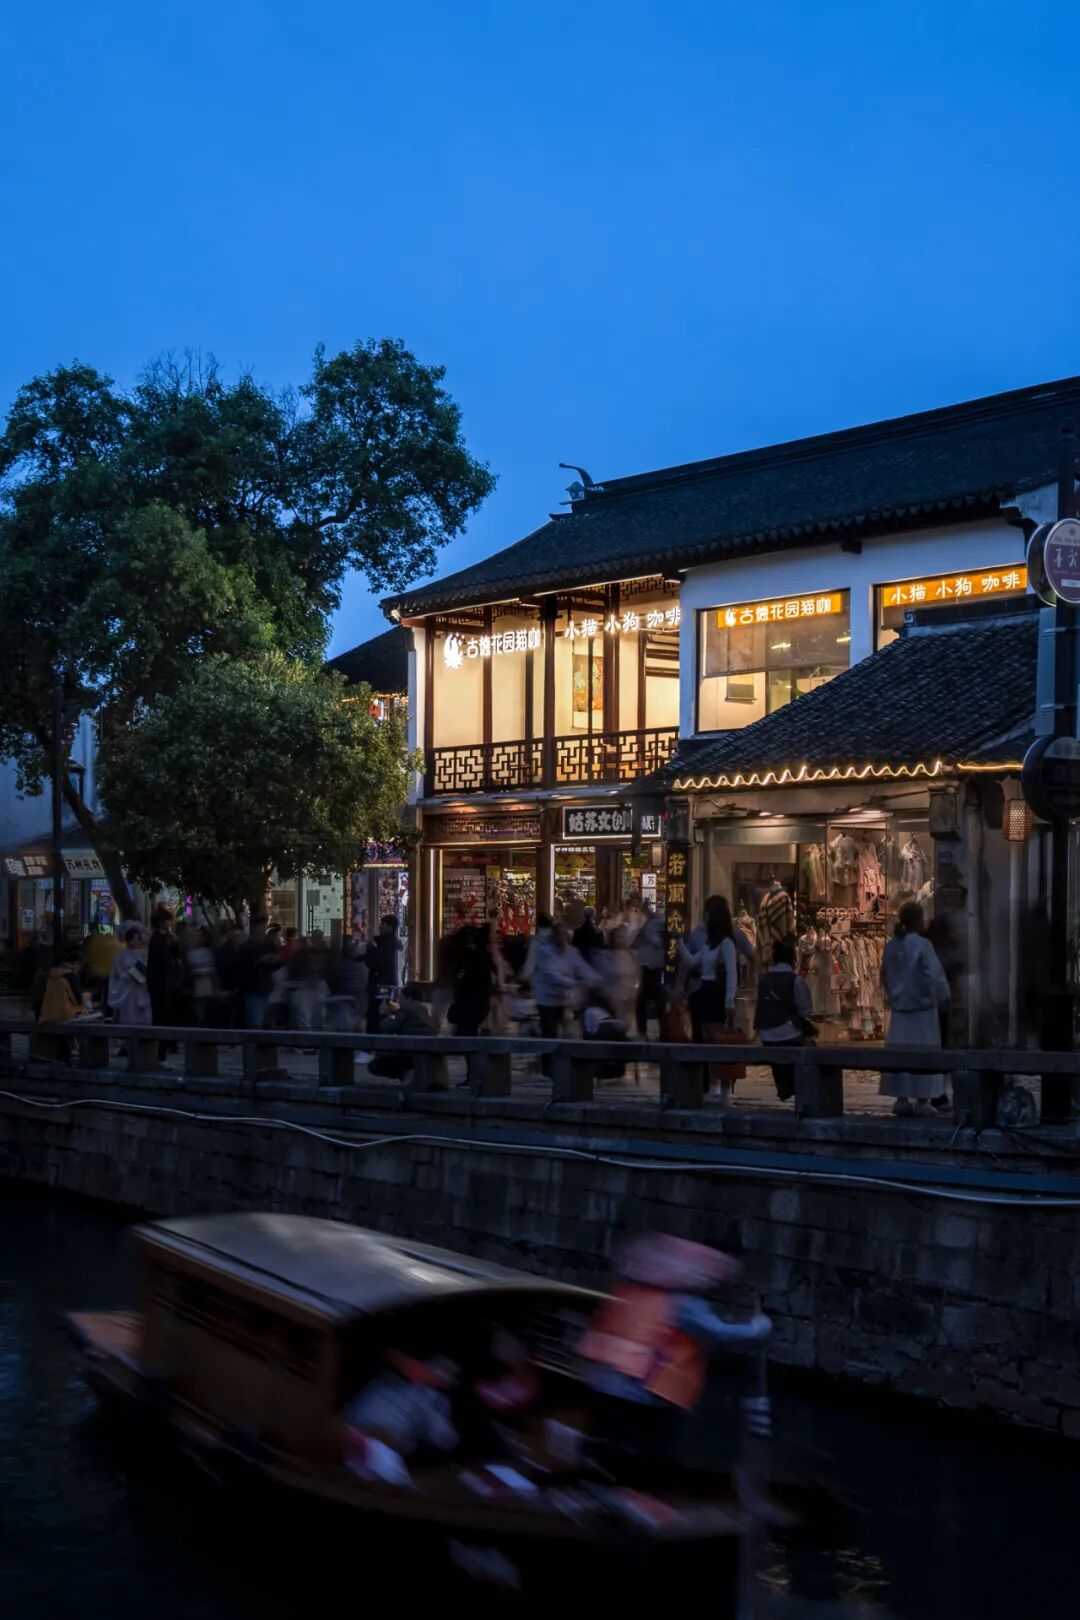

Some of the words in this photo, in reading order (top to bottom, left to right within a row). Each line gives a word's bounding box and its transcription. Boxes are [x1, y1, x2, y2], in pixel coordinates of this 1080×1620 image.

[891, 583, 926, 605] 小猫
[936, 577, 973, 598] 小狗
[981, 570, 1021, 592] 咖啡
[565, 618, 597, 640] 小猫
[605, 612, 640, 634] 小狗
[646, 606, 681, 627] 咖啡
